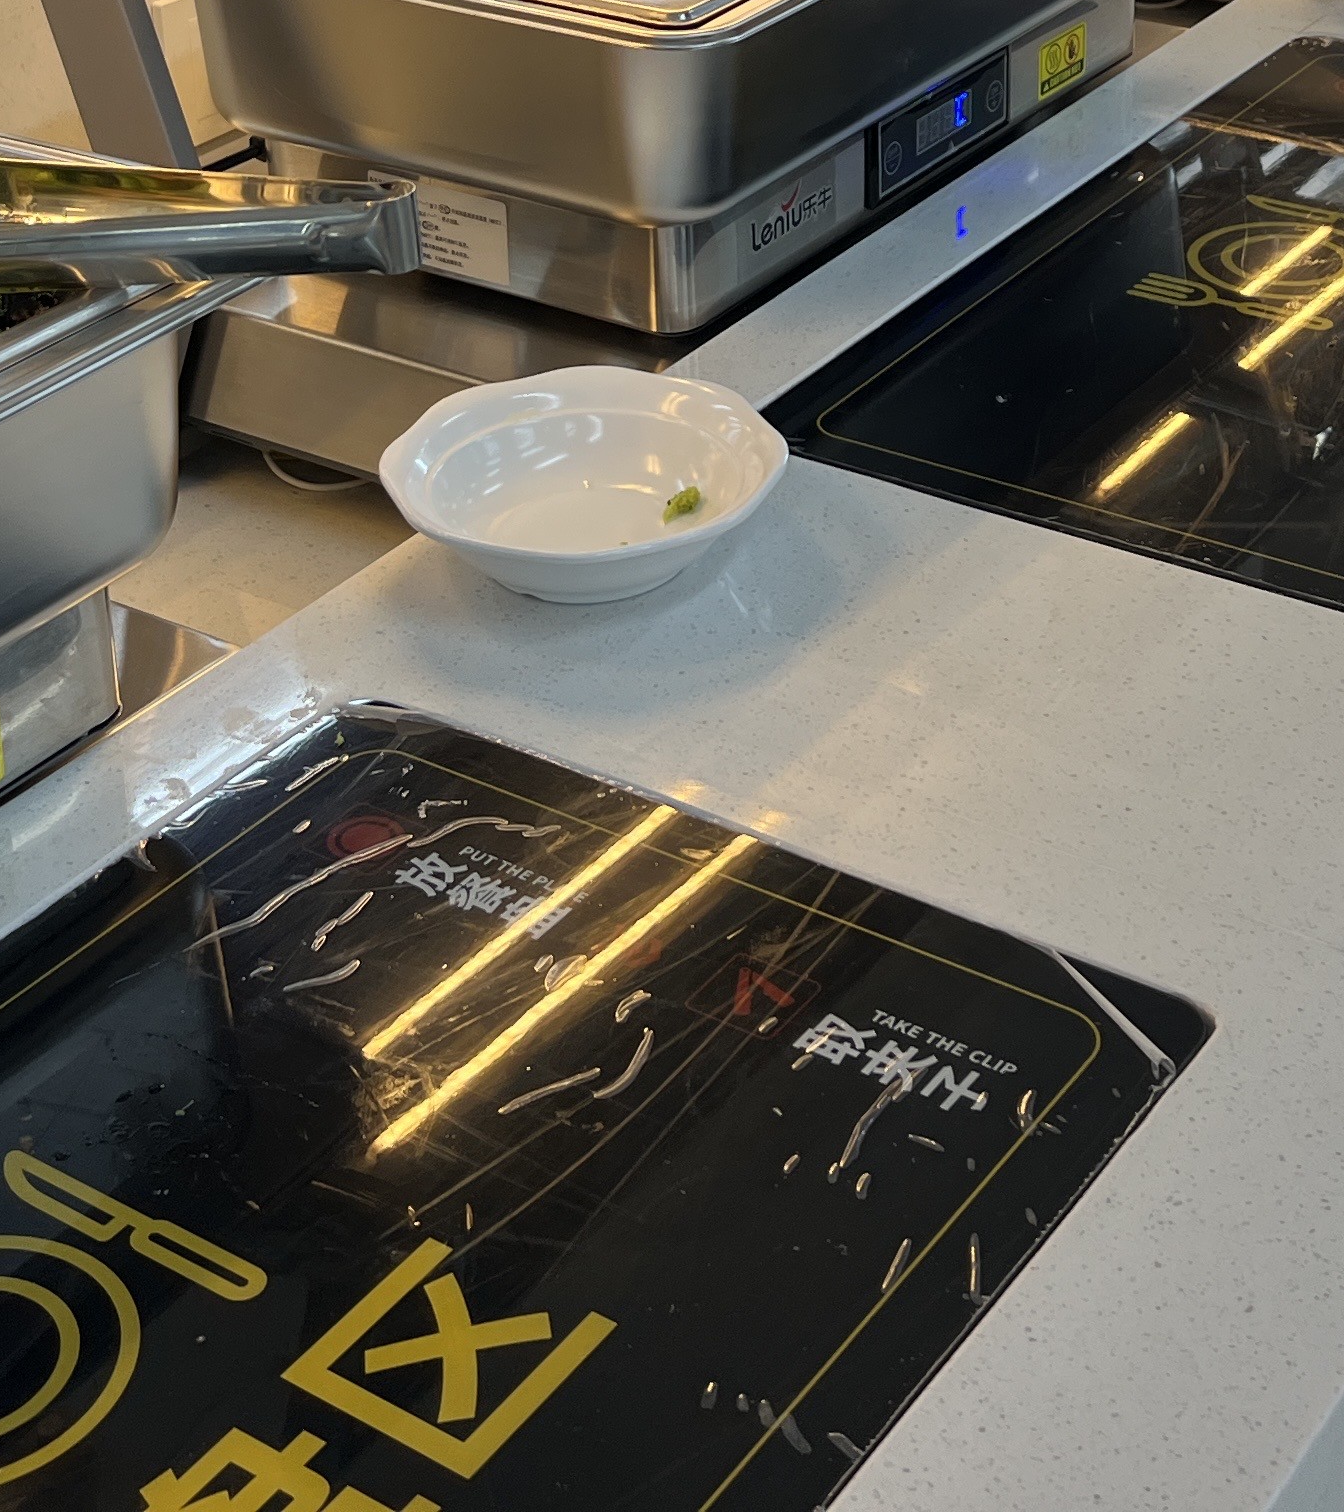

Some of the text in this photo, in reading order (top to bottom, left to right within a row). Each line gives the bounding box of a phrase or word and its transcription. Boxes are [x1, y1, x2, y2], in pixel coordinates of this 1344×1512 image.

[459, 845, 590, 904] PUT THE PLE
[872, 1009, 1018, 1075] TAKE THE CLIP
